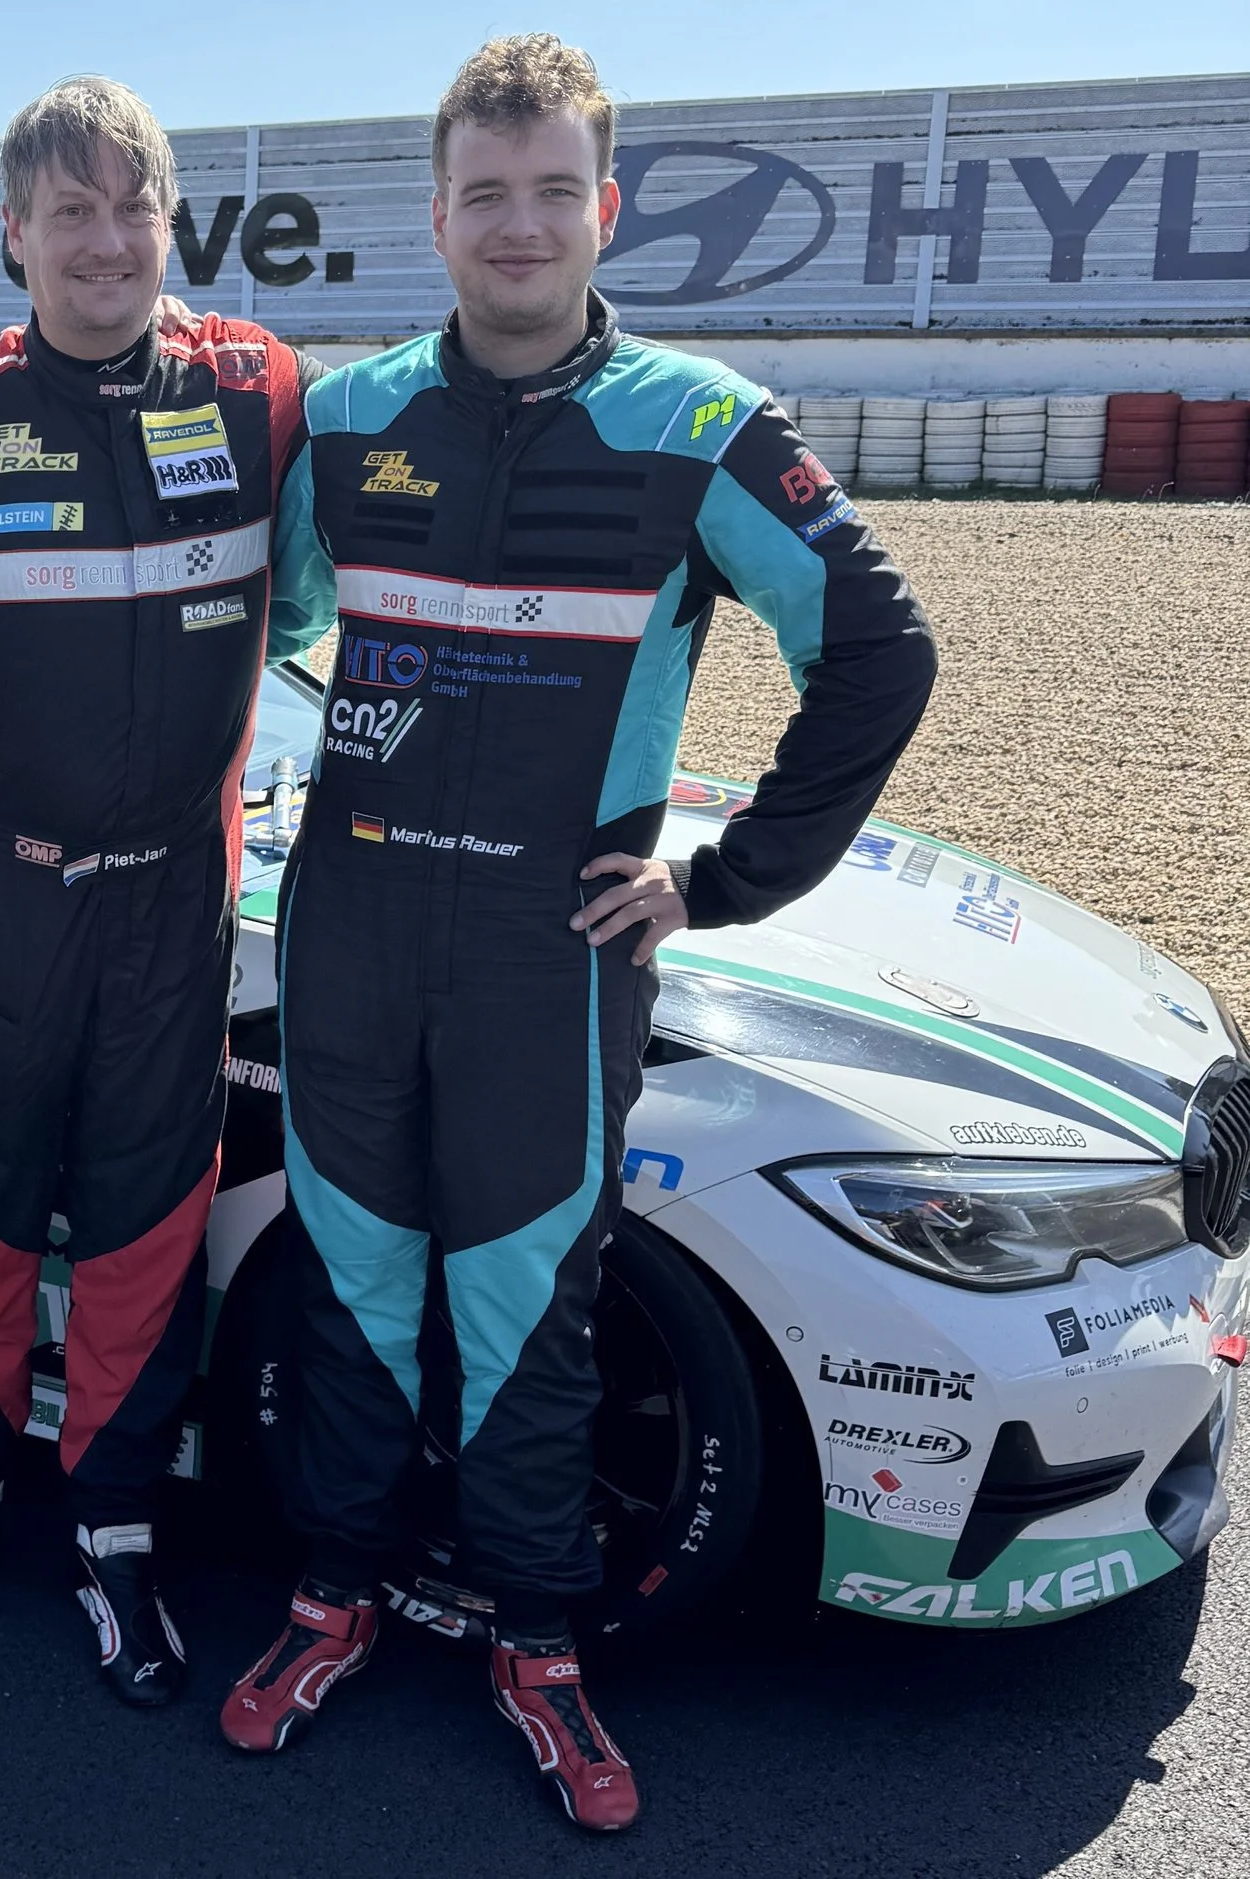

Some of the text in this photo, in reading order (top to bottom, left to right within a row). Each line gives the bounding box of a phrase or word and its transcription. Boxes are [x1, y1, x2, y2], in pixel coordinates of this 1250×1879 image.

[689, 393, 737, 441] P1
[153, 425, 213, 440] RAVENOL
[1, 441, 40, 455] ON
[367, 453, 403, 465] GET
[383, 467, 408, 477] ON
[368, 479, 434, 495] TRACK
[26, 565, 77, 592] sorg
[381, 592, 418, 615] sorg
[518, 654, 529, 666] &
[431, 681, 469, 698] GmbH
[331, 698, 398, 741] cn2
[326, 737, 375, 761] RACING
[15, 840, 63, 863] OMP
[390, 826, 524, 857] Marius Rauer
[104, 845, 168, 870] Piet-Jan
[950, 1121, 1087, 1148] aufkleben.de
[1084, 1294, 1176, 1334] FOLIAMEDIA
[1065, 1364, 1085, 1377] folie
[1095, 1353, 1123, 1369] design
[1132, 1345, 1151, 1359] print
[702, 1434, 723, 1474] Set
[824, 1436, 897, 1455] AUTOMOTIVE
[699, 1480, 717, 1493] 2
[824, 1482, 961, 1518] my cases
[834, 1549, 1139, 1618] FALKEN
